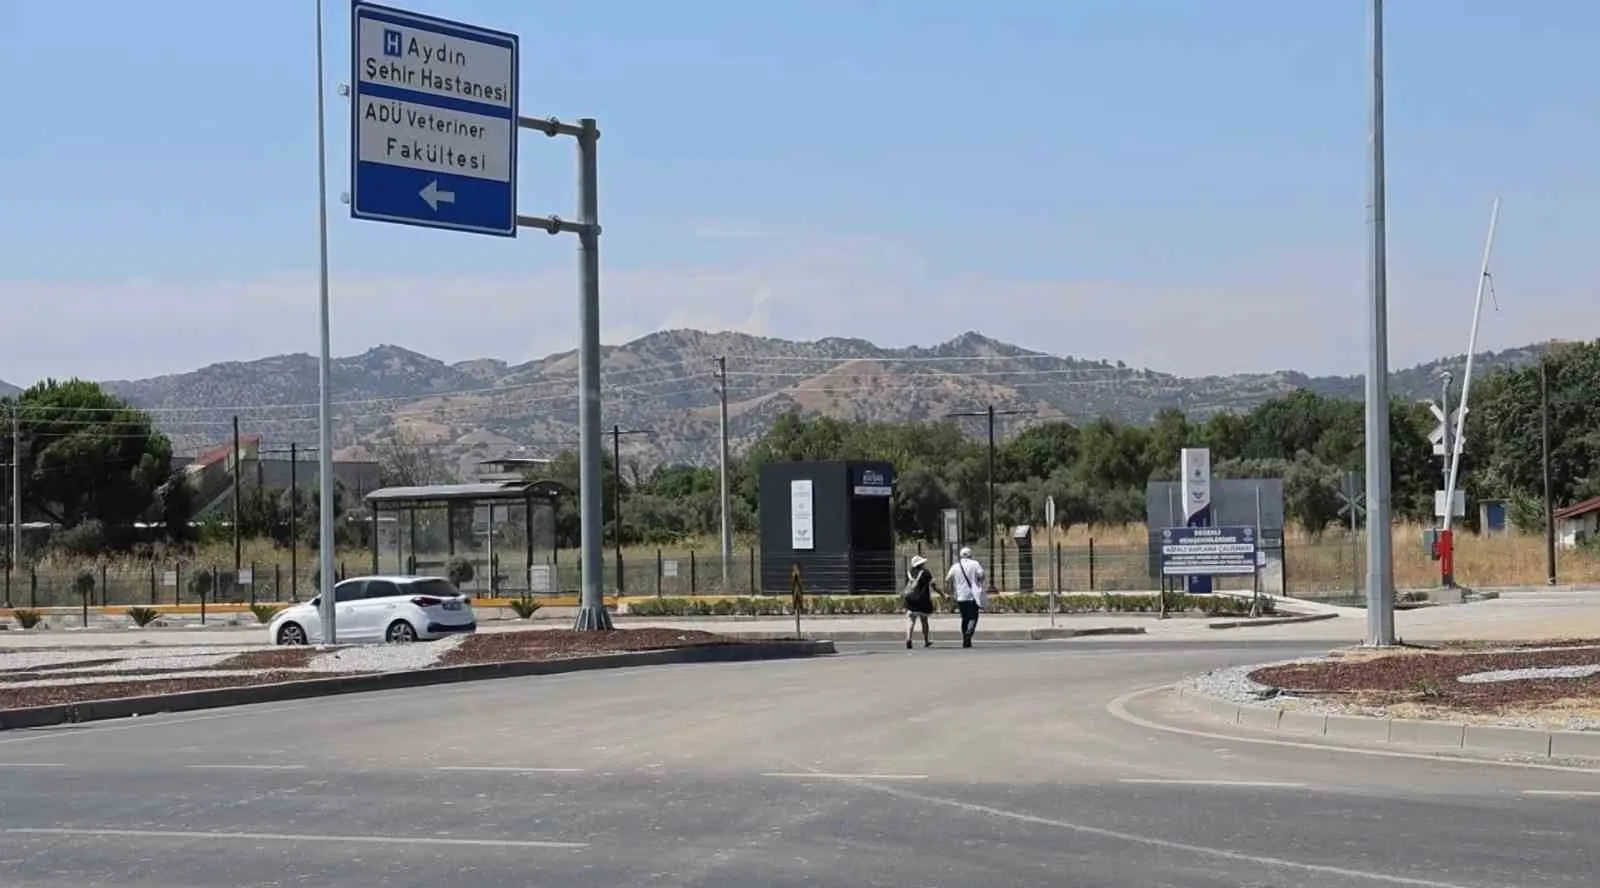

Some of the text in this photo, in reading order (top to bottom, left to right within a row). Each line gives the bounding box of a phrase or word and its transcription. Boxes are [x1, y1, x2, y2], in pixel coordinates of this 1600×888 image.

[408, 37, 466, 66] Aydın
[366, 57, 508, 101] Şehir Hastanesi
[365, 102, 486, 139] ADÜ Veteriner
[387, 138, 486, 171] Fakültesi
